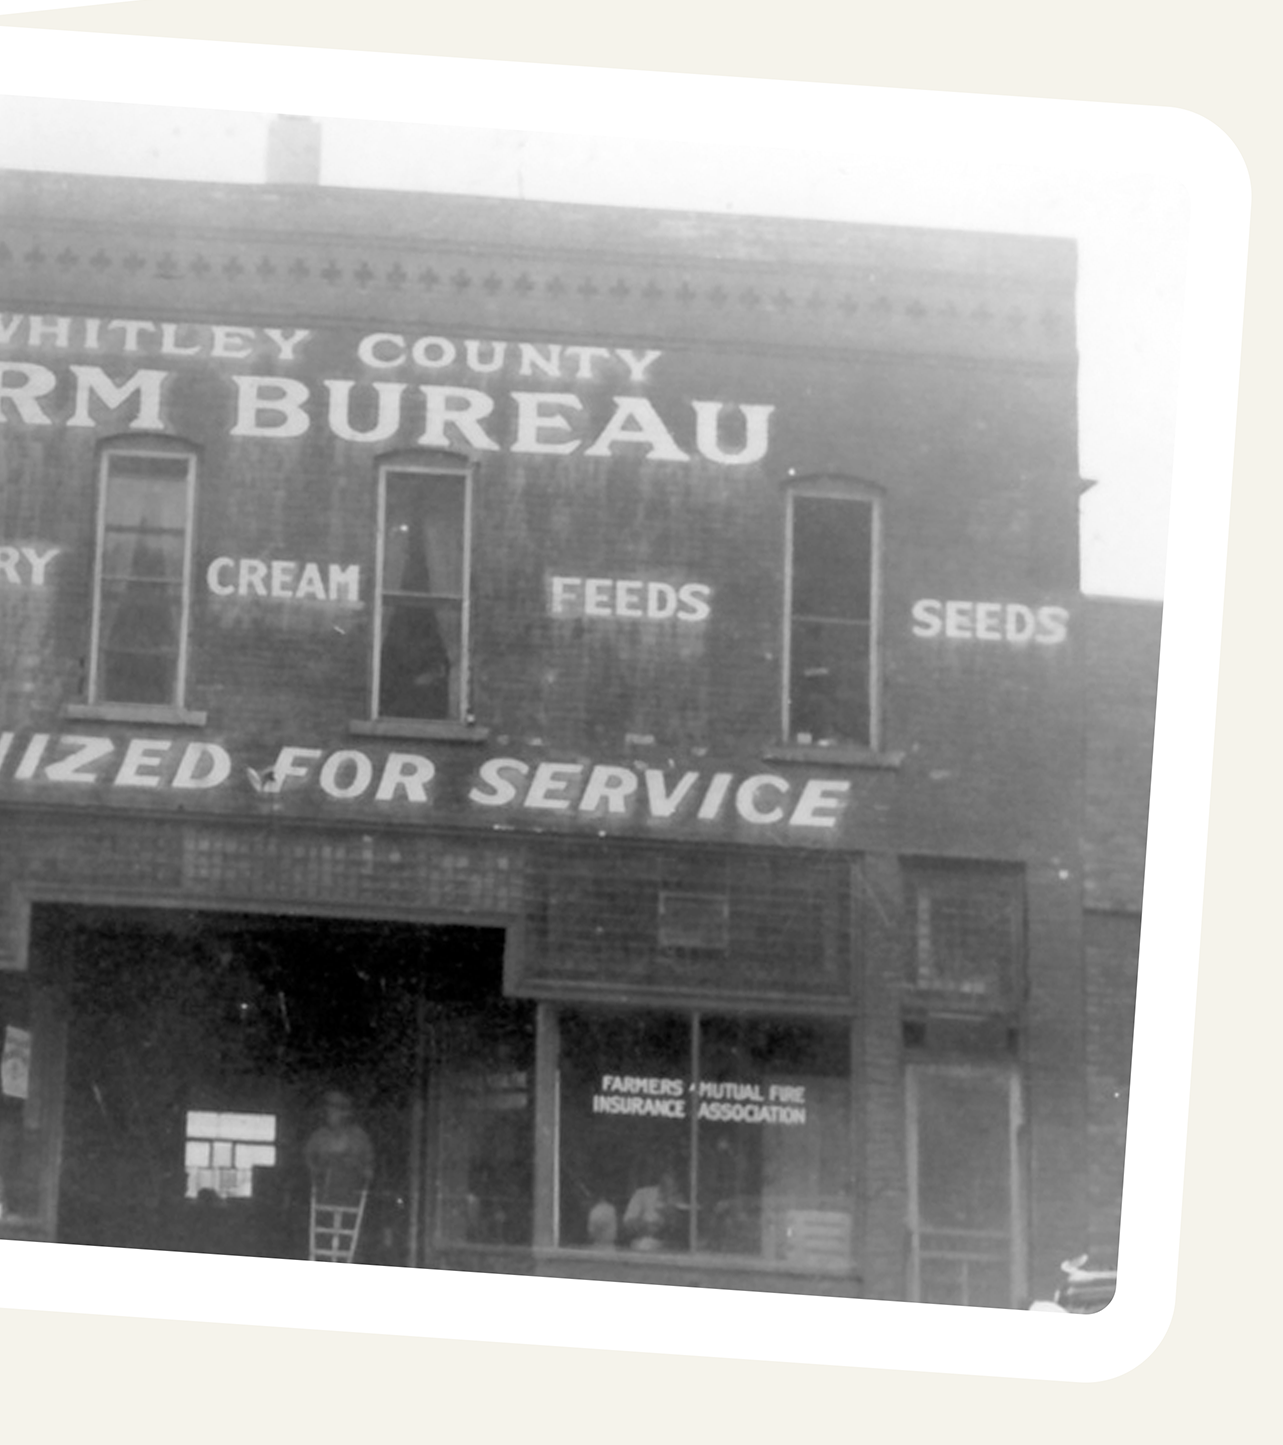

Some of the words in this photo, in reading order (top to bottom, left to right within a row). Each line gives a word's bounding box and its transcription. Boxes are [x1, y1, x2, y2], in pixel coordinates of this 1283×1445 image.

[357, 333, 662, 382] COUNTY
[232, 376, 775, 463] BUREAU
[207, 559, 360, 601] CREAM
[551, 576, 712, 621] FEEDS
[912, 598, 1070, 644] SEEDS
[264, 748, 436, 803] FOR
[468, 757, 851, 827] SERVICE
[592, 1095, 686, 1118] INSURANCE
[697, 1101, 806, 1124] ASSOCIATION
[700, 1081, 764, 1102] MUTUAL
[769, 1085, 806, 1103] FIRE
